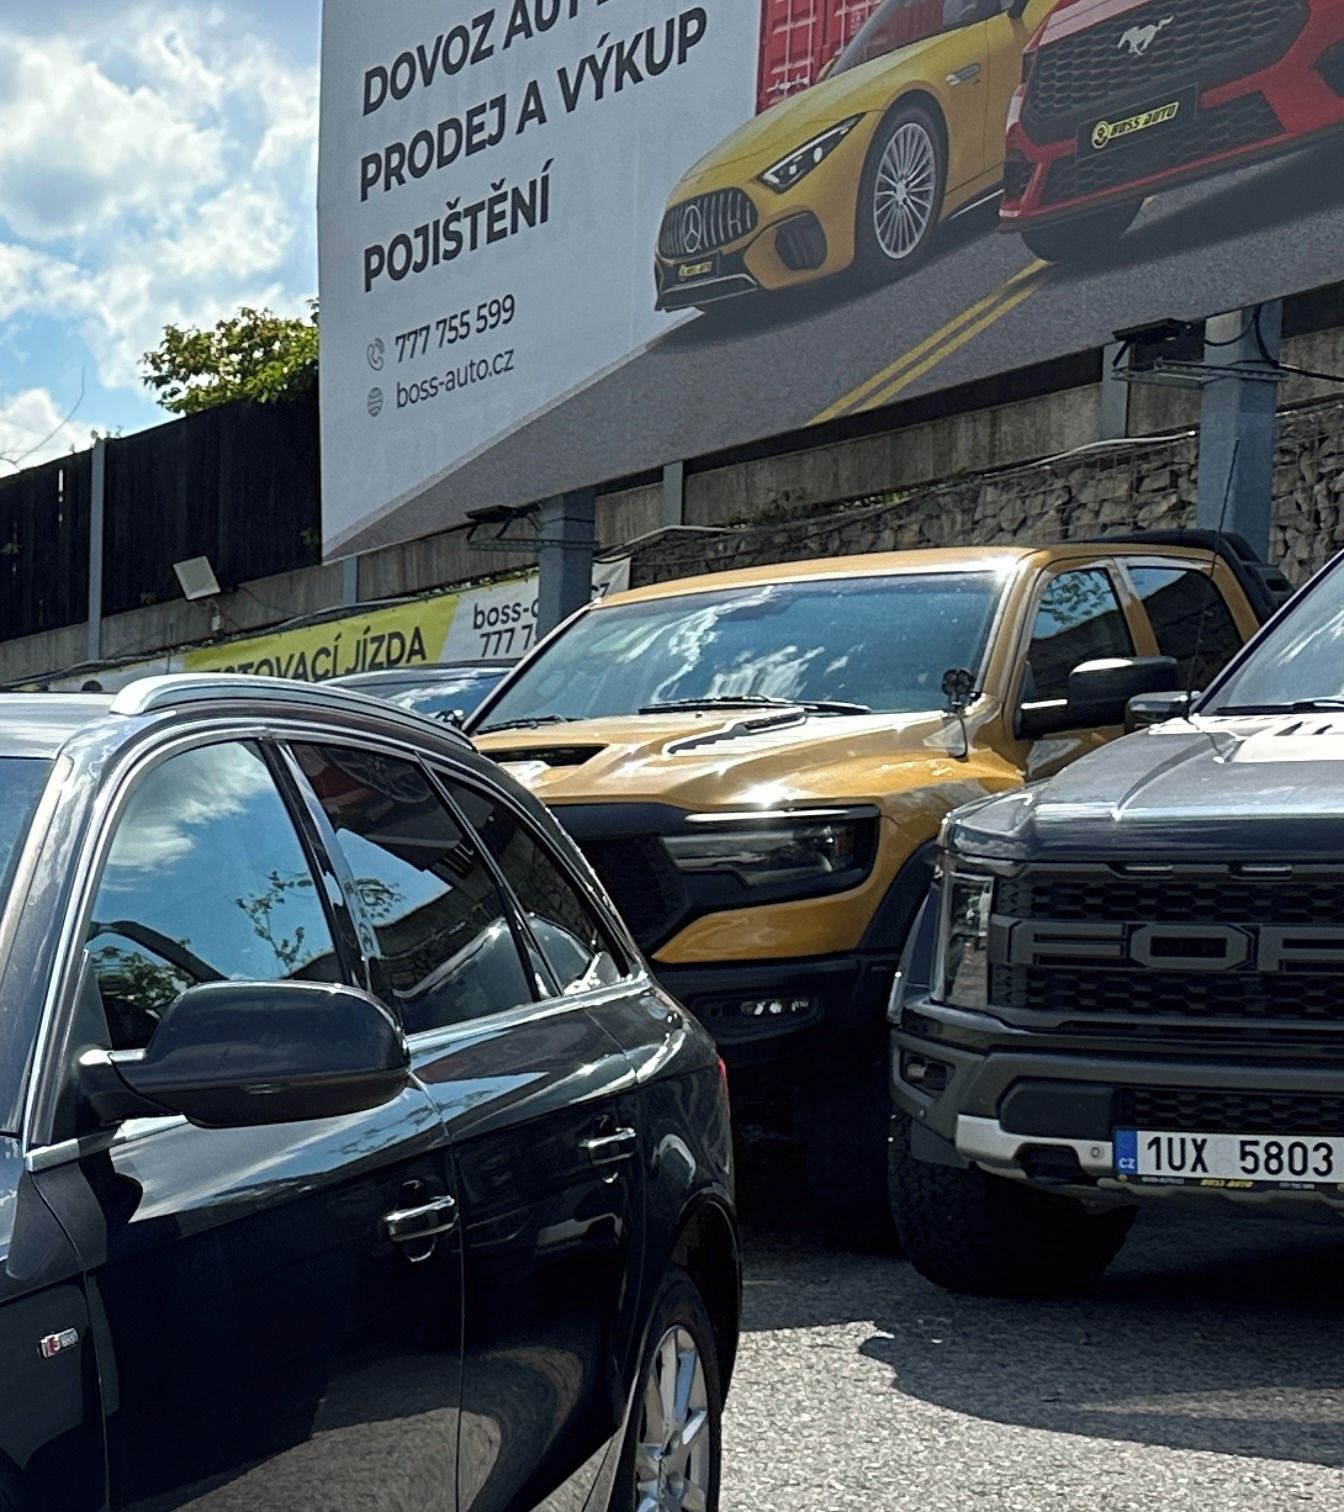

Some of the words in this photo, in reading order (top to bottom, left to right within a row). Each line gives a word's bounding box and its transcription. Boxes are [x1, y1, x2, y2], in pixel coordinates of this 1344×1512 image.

[362, 8, 496, 117] DOVOZ
[360, 93, 507, 202] PRODEJ
[515, 79, 548, 136] A
[556, 6, 708, 114] VÝKUP
[363, 157, 555, 293] POJIŠTĚNÍ
[395, 324, 431, 363] 777
[435, 309, 471, 349] 755
[476, 294, 515, 334] 599
[396, 348, 515, 409] boss-auto.cz
[344, 625, 427, 676] JÍZDA
[480, 627, 515, 658] 777
[1119, 1157, 1136, 1169] CZ
[1147, 1136, 1209, 1173] 1UX
[1239, 1140, 1334, 1177] 5803
